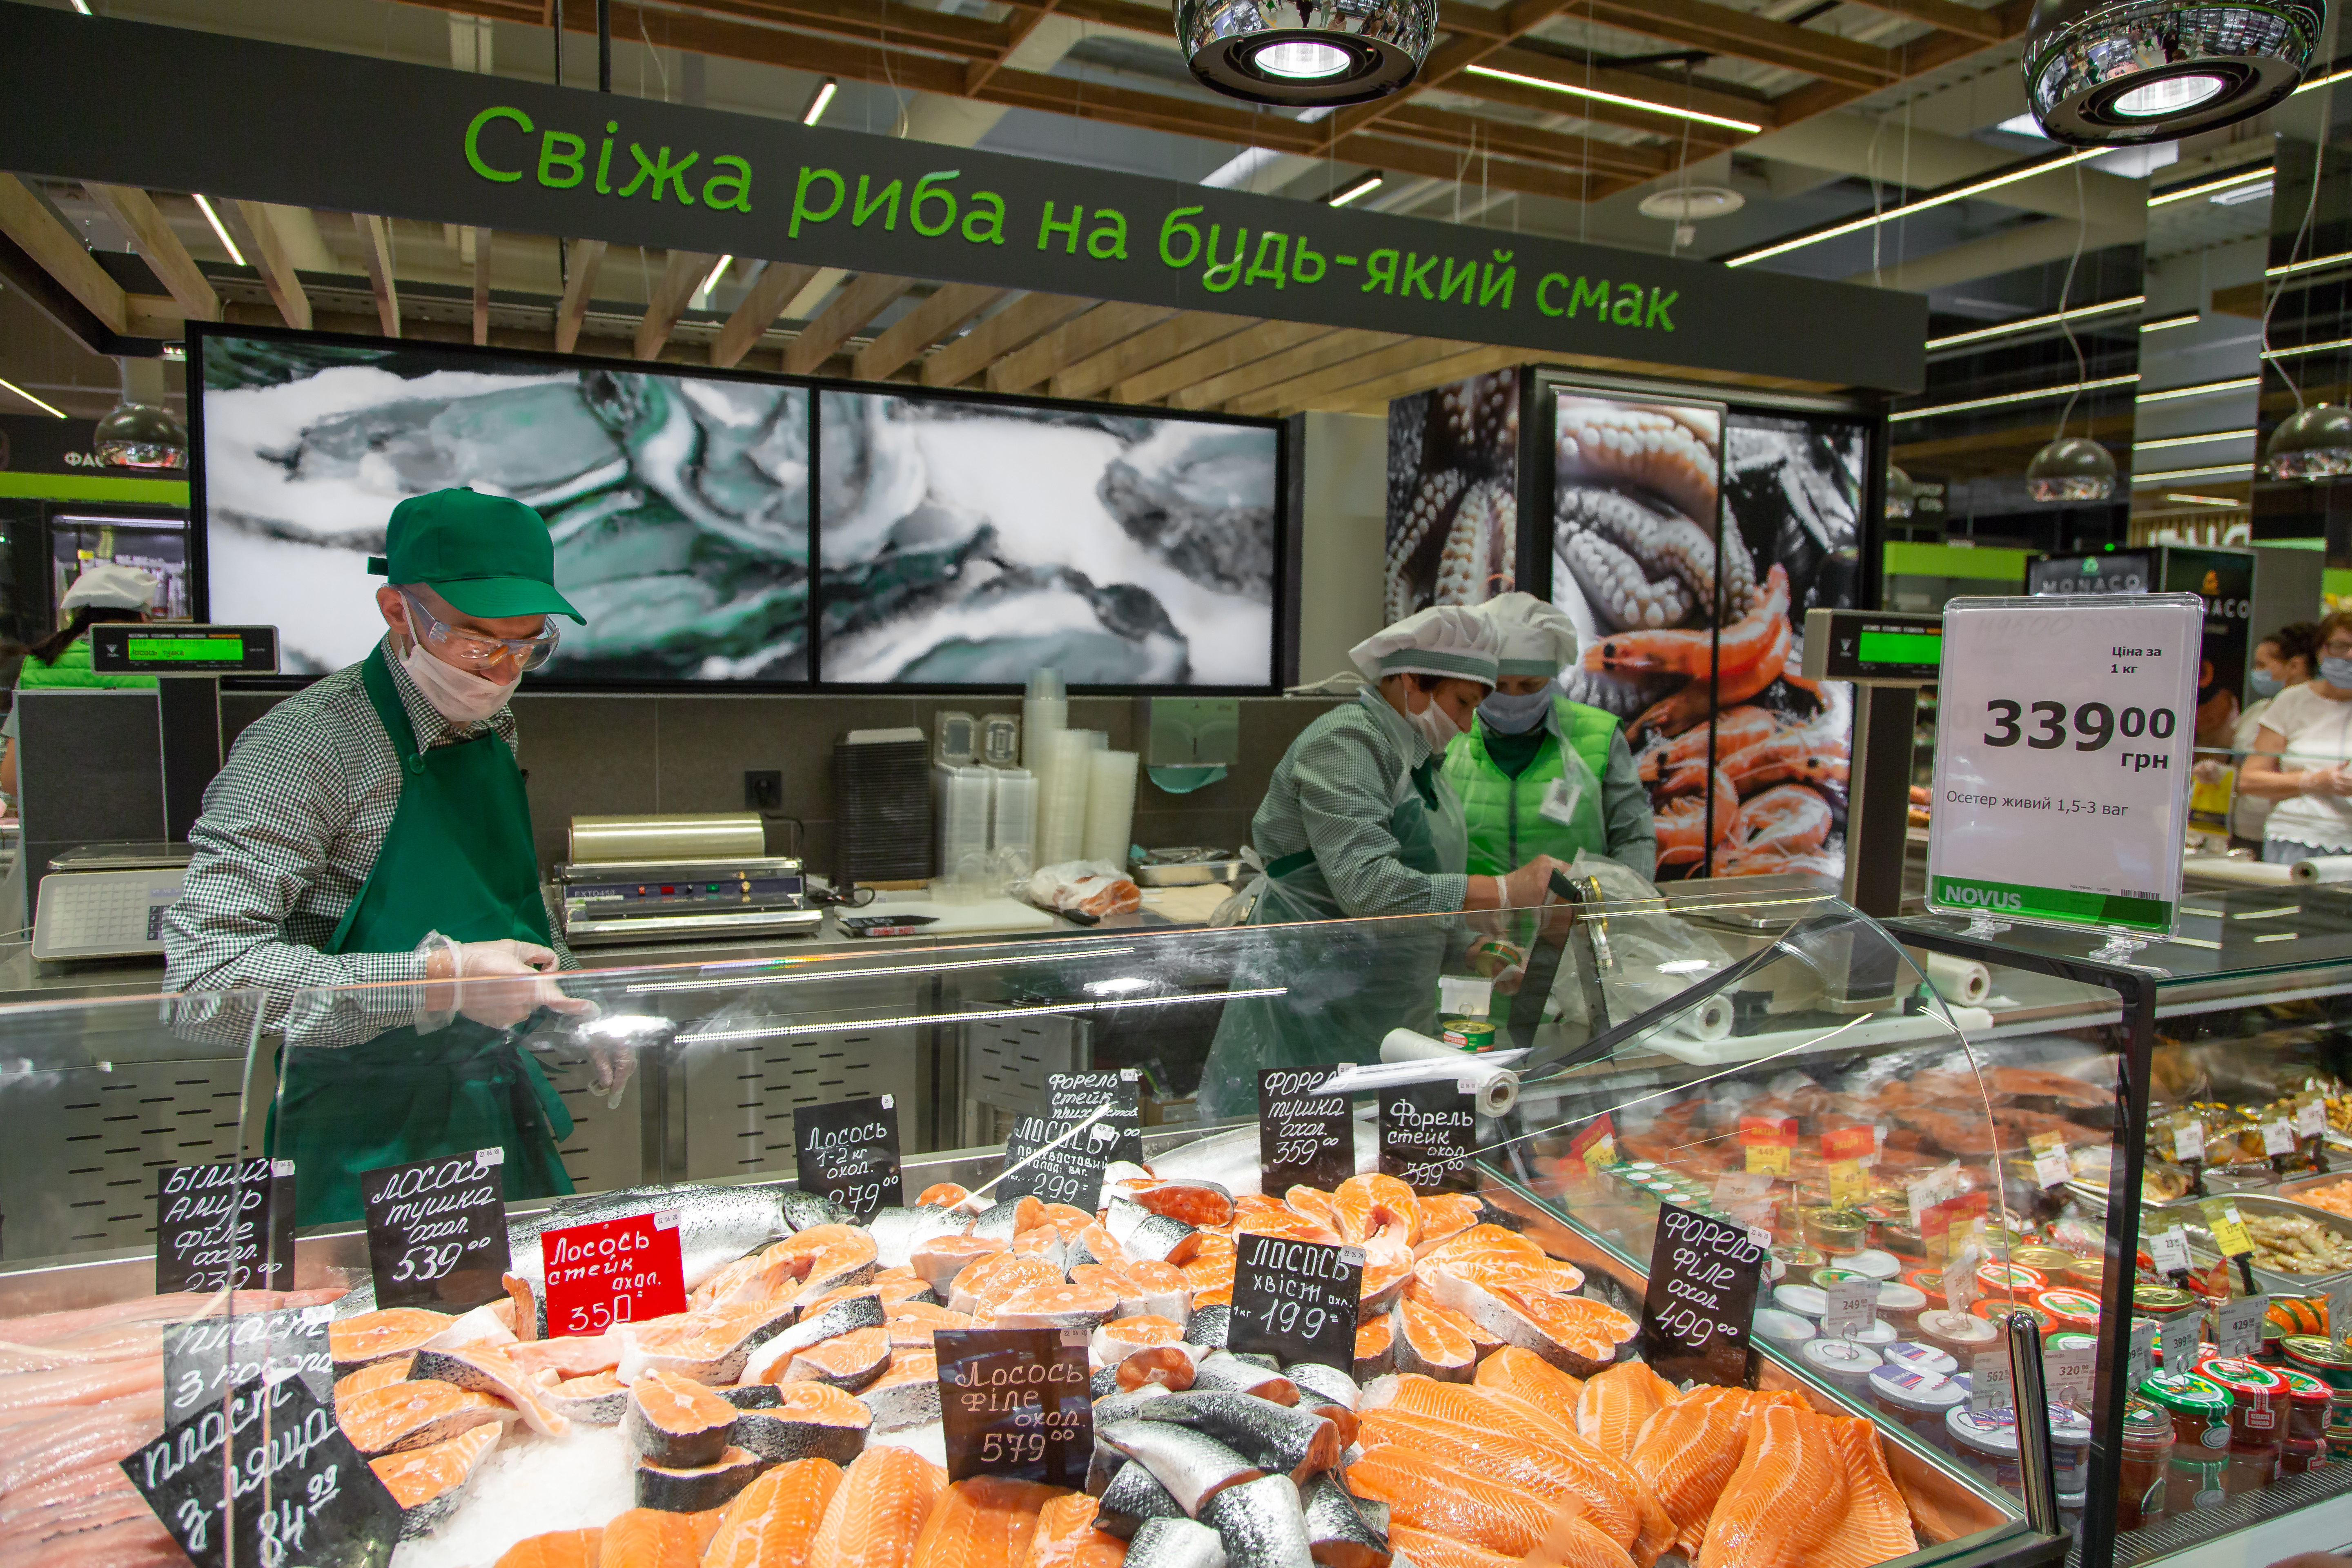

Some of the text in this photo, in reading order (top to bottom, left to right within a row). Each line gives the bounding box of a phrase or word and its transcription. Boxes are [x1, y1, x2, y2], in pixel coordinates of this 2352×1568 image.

[464, 106, 1679, 332] Свіжа риба на будь-який смак
[2042, 574, 2140, 593] MONACO
[2112, 646, 2162, 658] Ціна за
[2111, 664, 2118, 673] 1
[2122, 751, 2169, 772] грн
[1946, 791, 2129, 817] Осетер живий 1,5-3 ваг
[1945, 885, 2021, 909] NOVUS
[1049, 1073, 1118, 1091] Форель
[1052, 1091, 1119, 1105] стейк
[1268, 1097, 1345, 1125] тушка
[1390, 1098, 1473, 1129] Форель
[805, 1123, 887, 1151] Лосось
[1280, 1123, 1327, 1137] охол.
[1388, 1128, 1450, 1145] стейк
[852, 1149, 867, 1160] кг
[1017, 1145, 1108, 1170] ПРХВОСТОВИЙ
[827, 1161, 874, 1179] охол.
[165, 1189, 262, 1230] Амур
[385, 1186, 496, 1231] тушка
[408, 1216, 468, 1244] охол.
[175, 1222, 254, 1261] філе
[550, 1230, 650, 1265] Лосось
[548, 1254, 633, 1285] стейк
[1673, 1247, 1735, 1290] філе
[612, 1272, 662, 1290] охол.
[1667, 1279, 1719, 1310] охол.
[1843, 1300, 1860, 1310] 249
[2232, 1319, 2248, 1330] 429
[2174, 1336, 2187, 1349] 399
[955, 1361, 1084, 1387] Лосось
[1987, 1370, 2003, 1382] 562
[2059, 1365, 2080, 1376] 320
[1015, 1410, 1086, 1428] охол.
